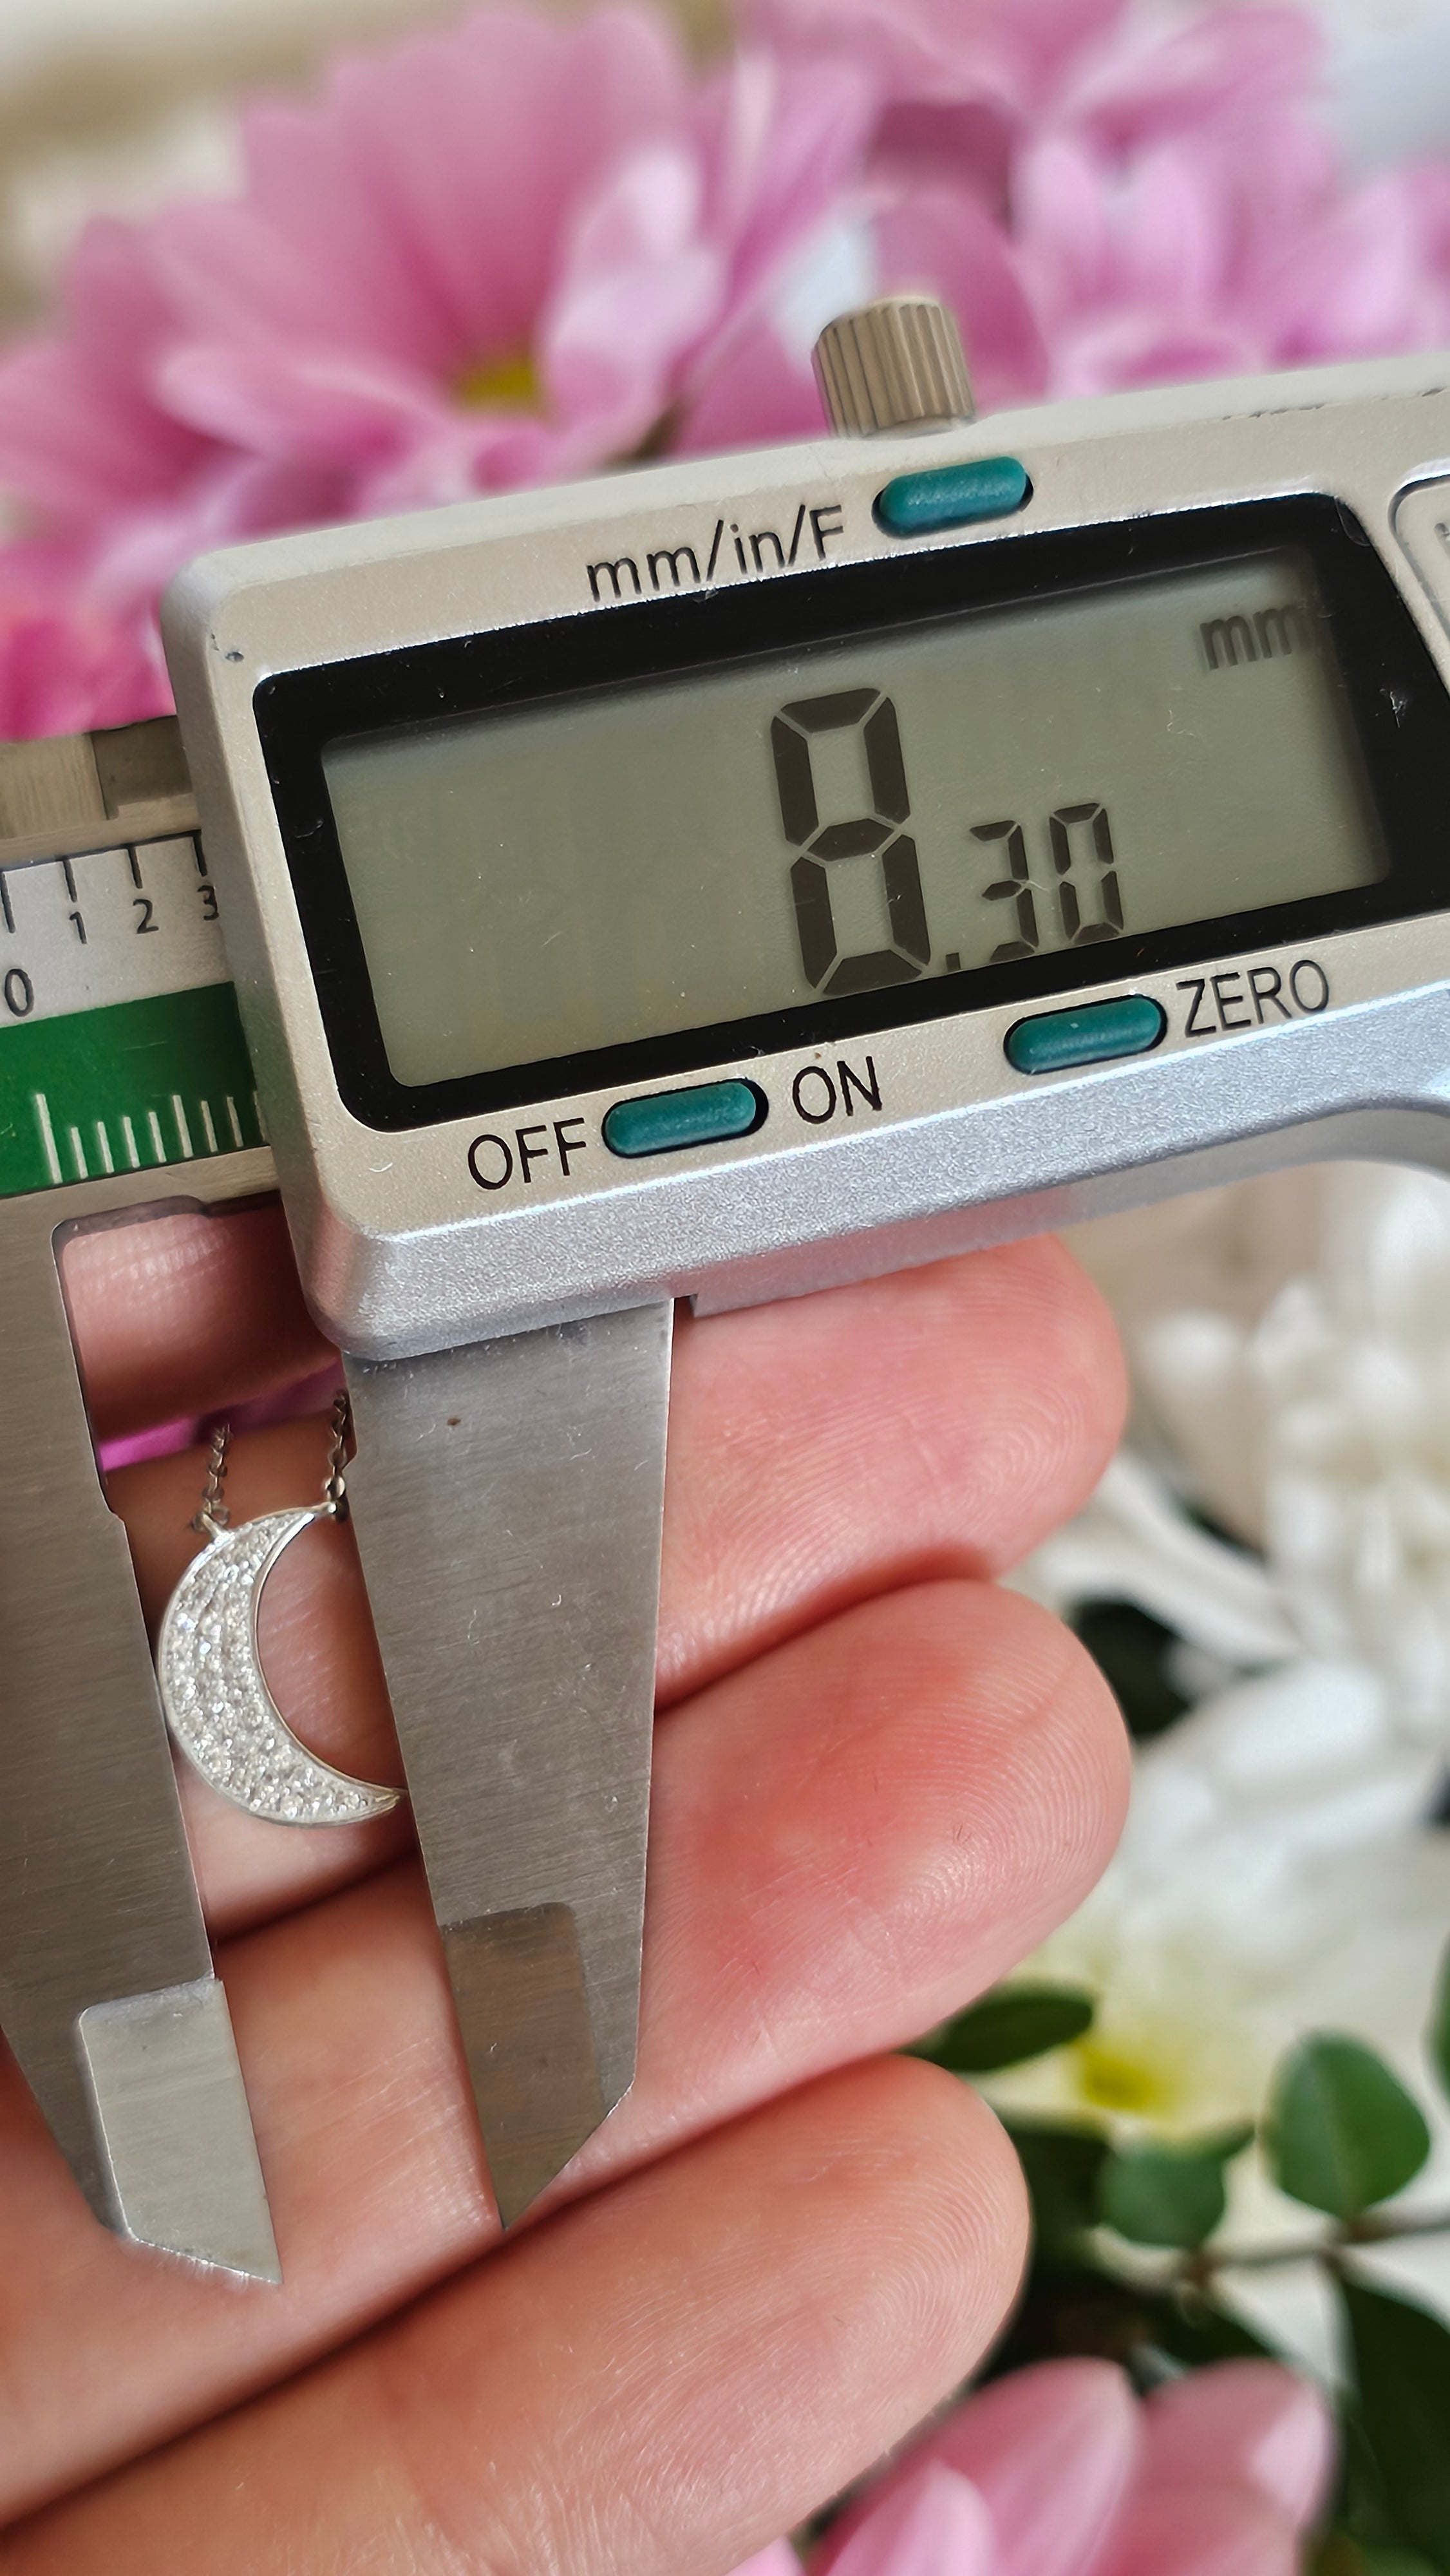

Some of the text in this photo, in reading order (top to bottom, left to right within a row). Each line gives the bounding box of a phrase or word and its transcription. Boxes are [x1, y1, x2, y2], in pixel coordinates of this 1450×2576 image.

[587, 504, 843, 601] mm/in/F
[1200, 604, 1312, 670] mm
[771, 688, 1124, 995] 8.30
[70, 885, 219, 944] 1 2 3
[4, 968, 33, 1018] 0
[1176, 960, 1330, 1037] ZERO
[792, 1056, 883, 1124] ON
[467, 1117, 587, 1190] OFF
